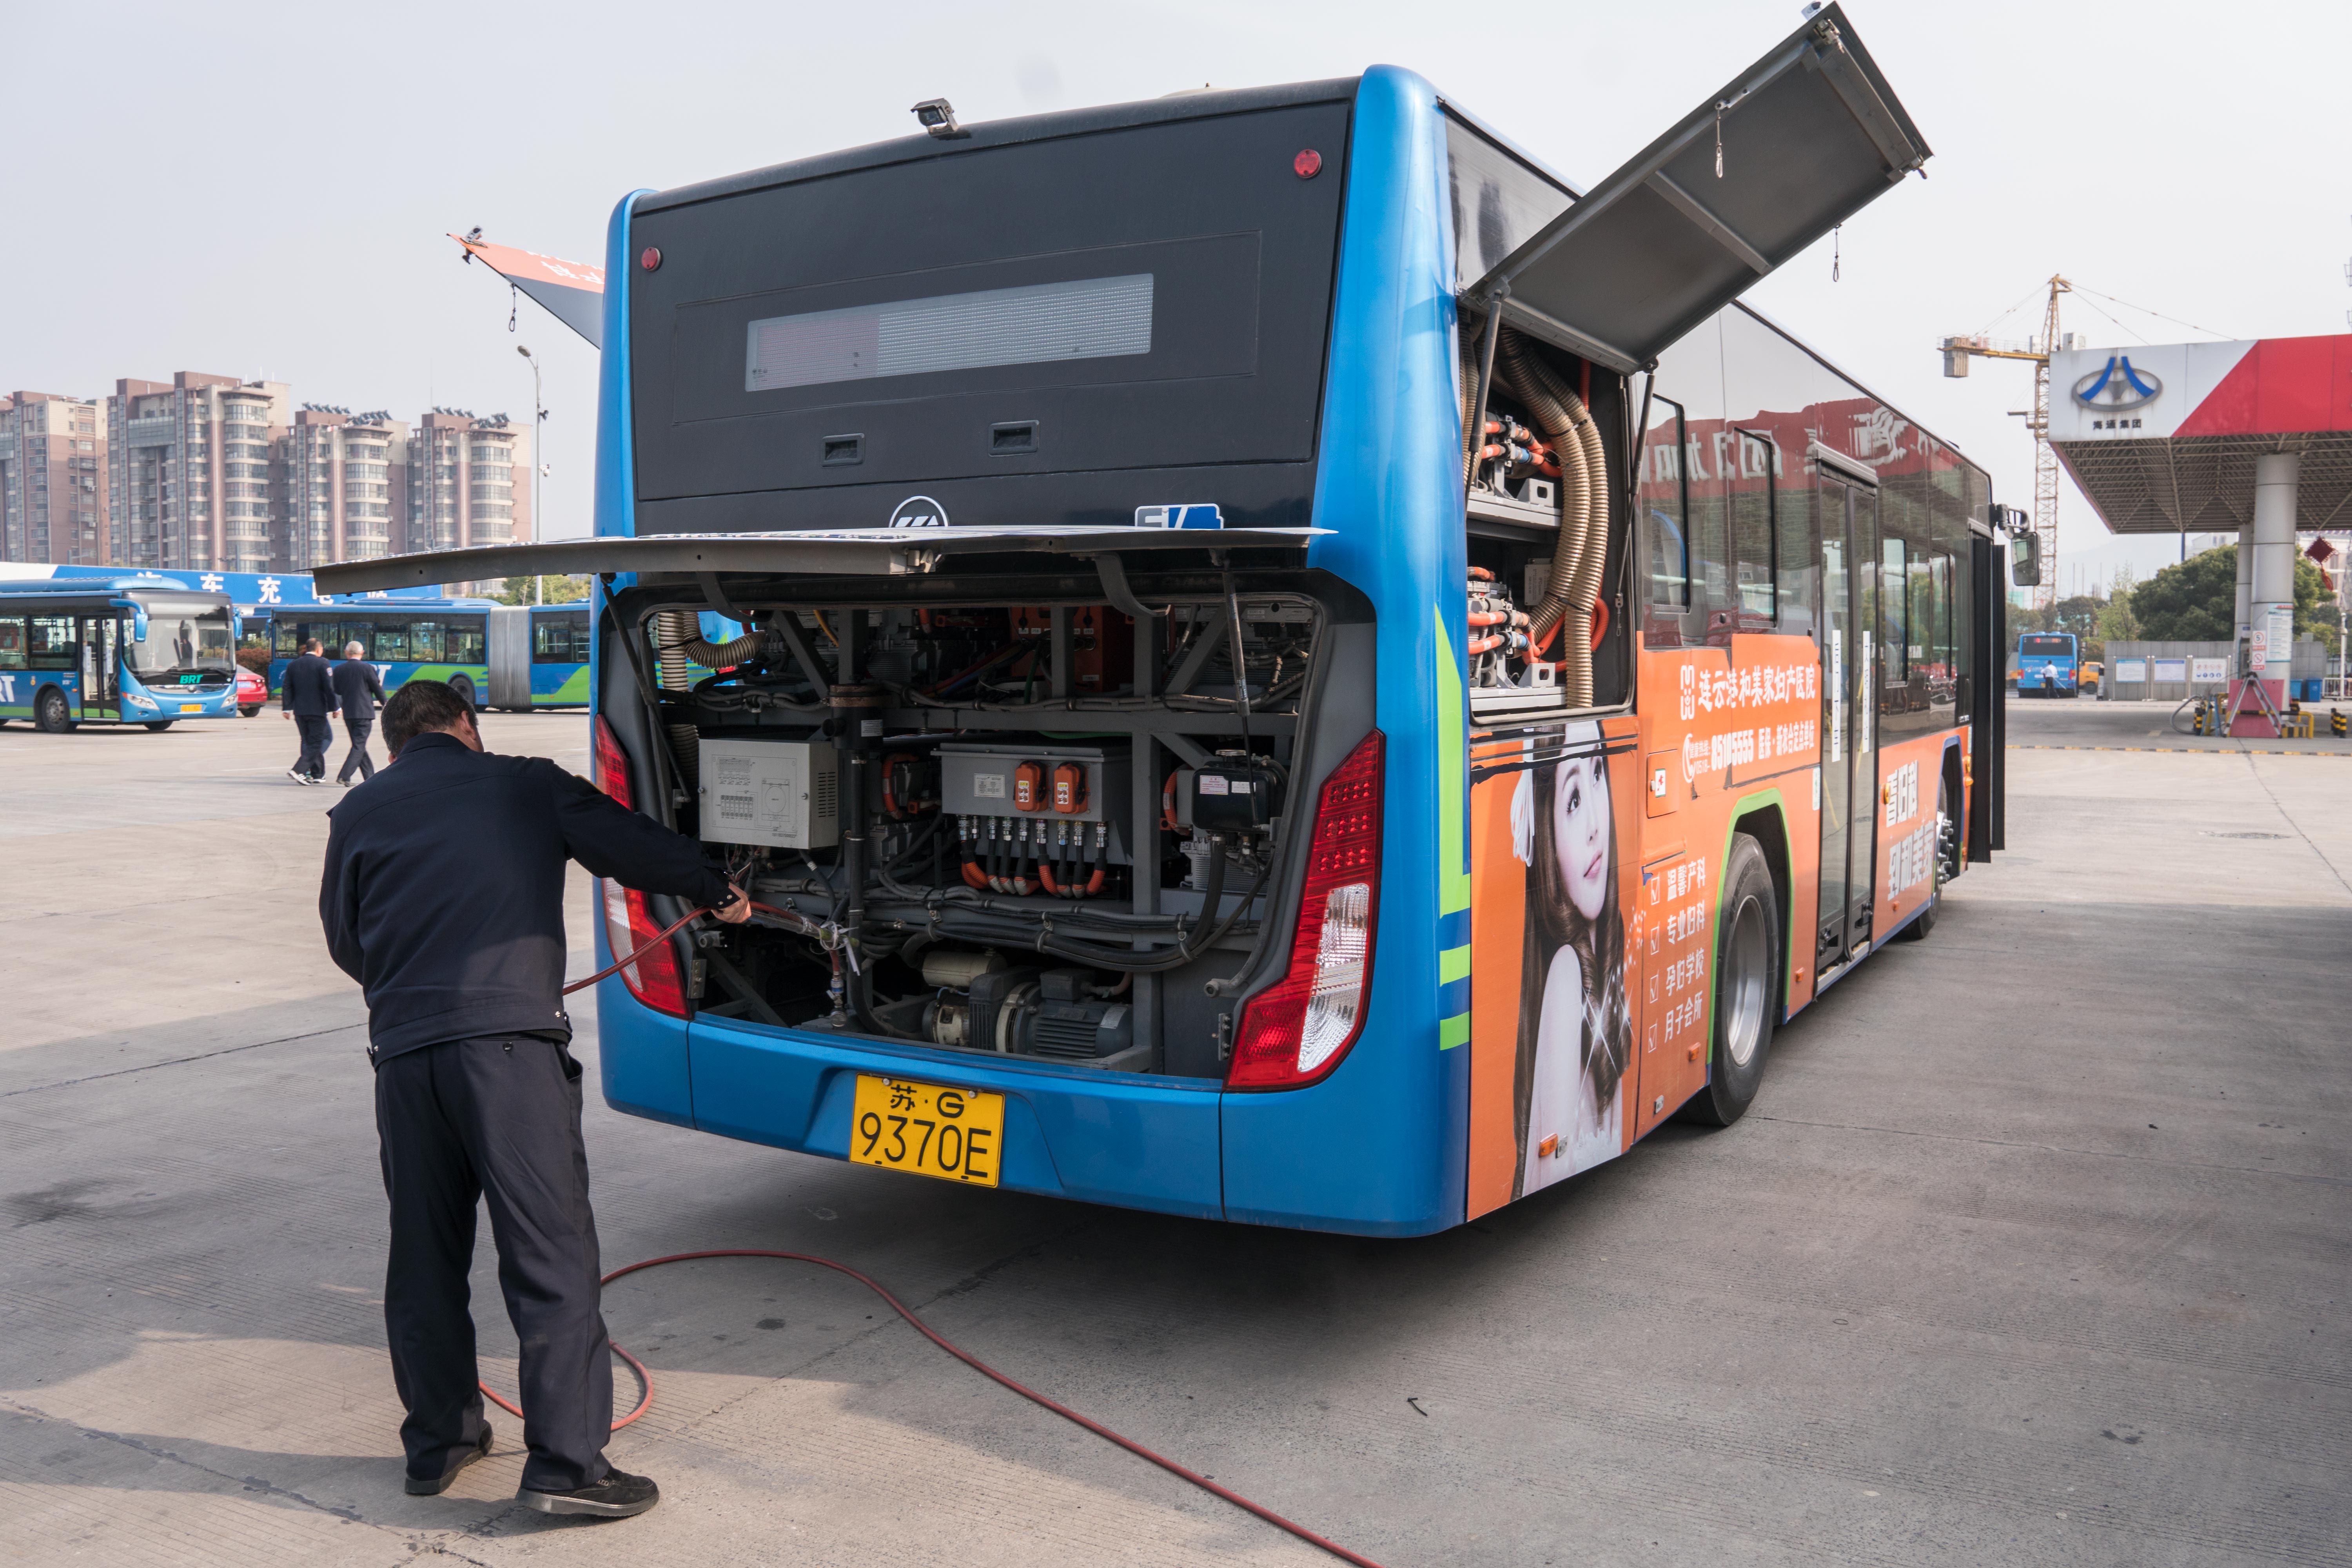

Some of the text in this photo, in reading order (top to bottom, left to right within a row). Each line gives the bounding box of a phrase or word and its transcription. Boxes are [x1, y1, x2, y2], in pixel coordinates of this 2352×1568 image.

[2093, 419, 2141, 430] 海通集团
[180, 675, 203, 684] BRT
[1698, 663, 1815, 712] 连云港和美家妇产医院
[1711, 729, 1754, 771] 85105555
[1886, 760, 1918, 828] 看妇科
[1667, 857, 1706, 902] 温馨产科
[1888, 820, 1934, 901] 到和美家
[1667, 900, 1705, 945] 专业妇科
[1666, 947, 1704, 997] 孕妇学校
[1664, 991, 1703, 1043] 月子会所
[860, 1112, 991, 1178] 9370E
